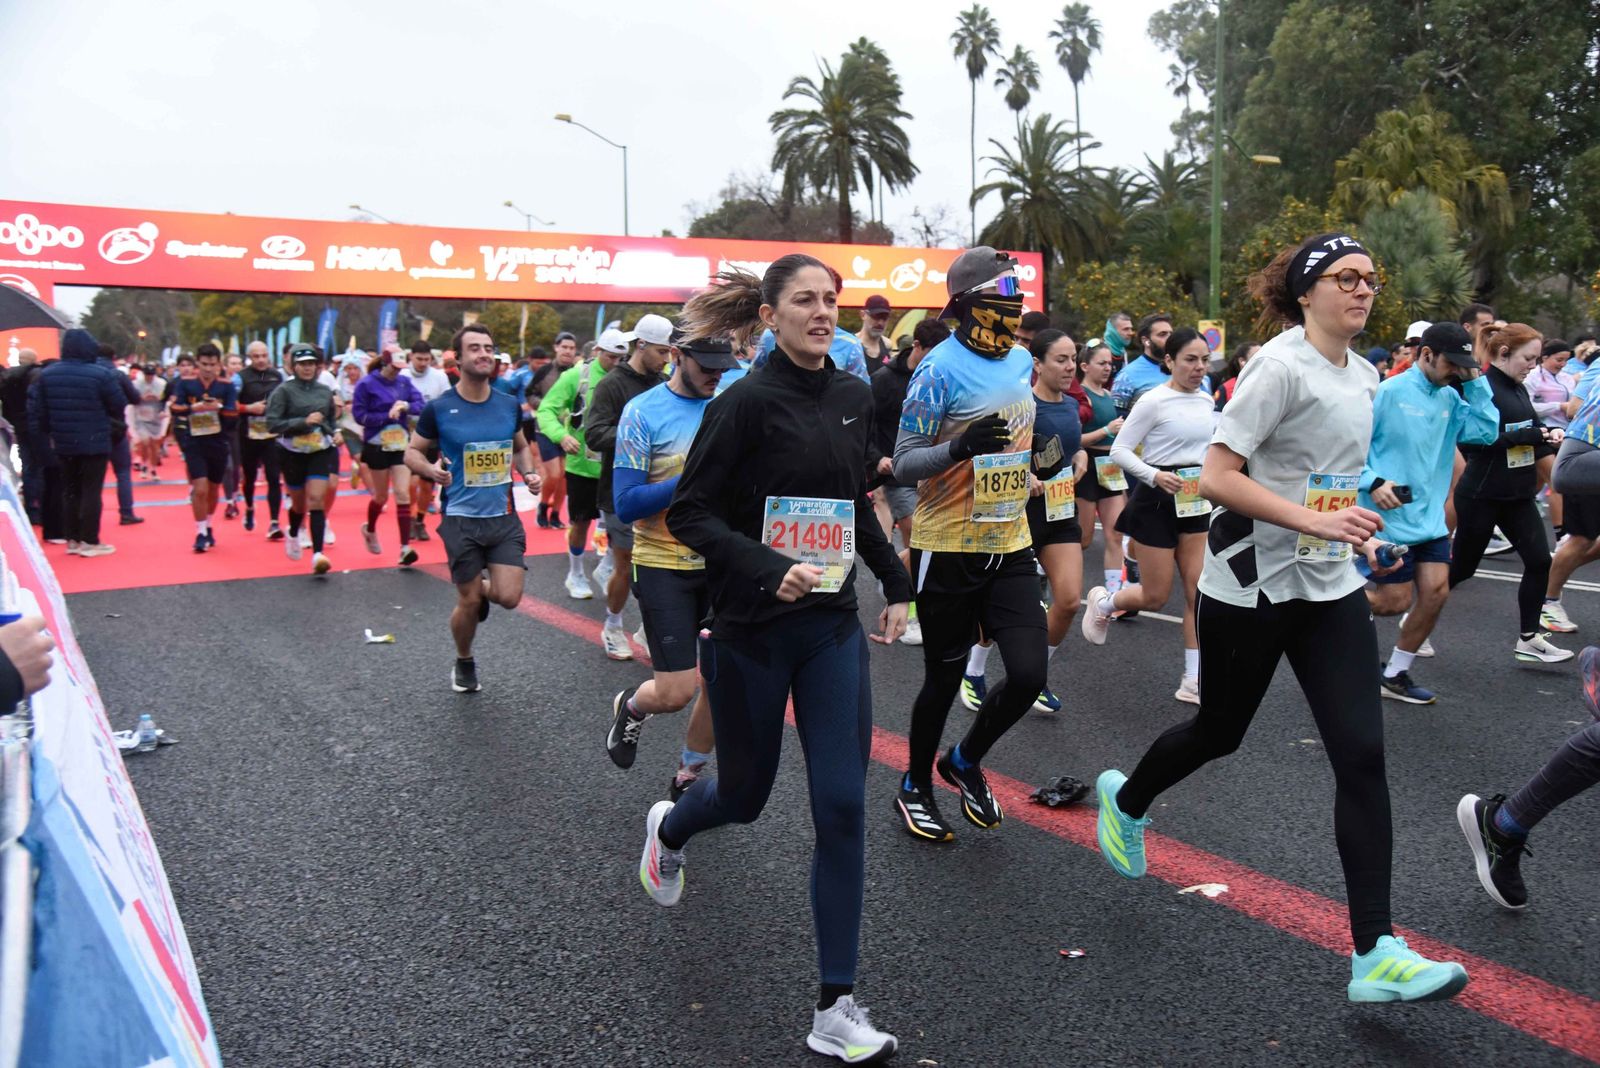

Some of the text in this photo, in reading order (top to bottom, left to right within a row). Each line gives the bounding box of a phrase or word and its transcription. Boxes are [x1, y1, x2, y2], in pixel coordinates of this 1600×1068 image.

[325, 245, 405, 271] HOKA
[469, 452, 505, 467] 15501
[981, 469, 1026, 493] 18739
[771, 521, 842, 550] 21490
